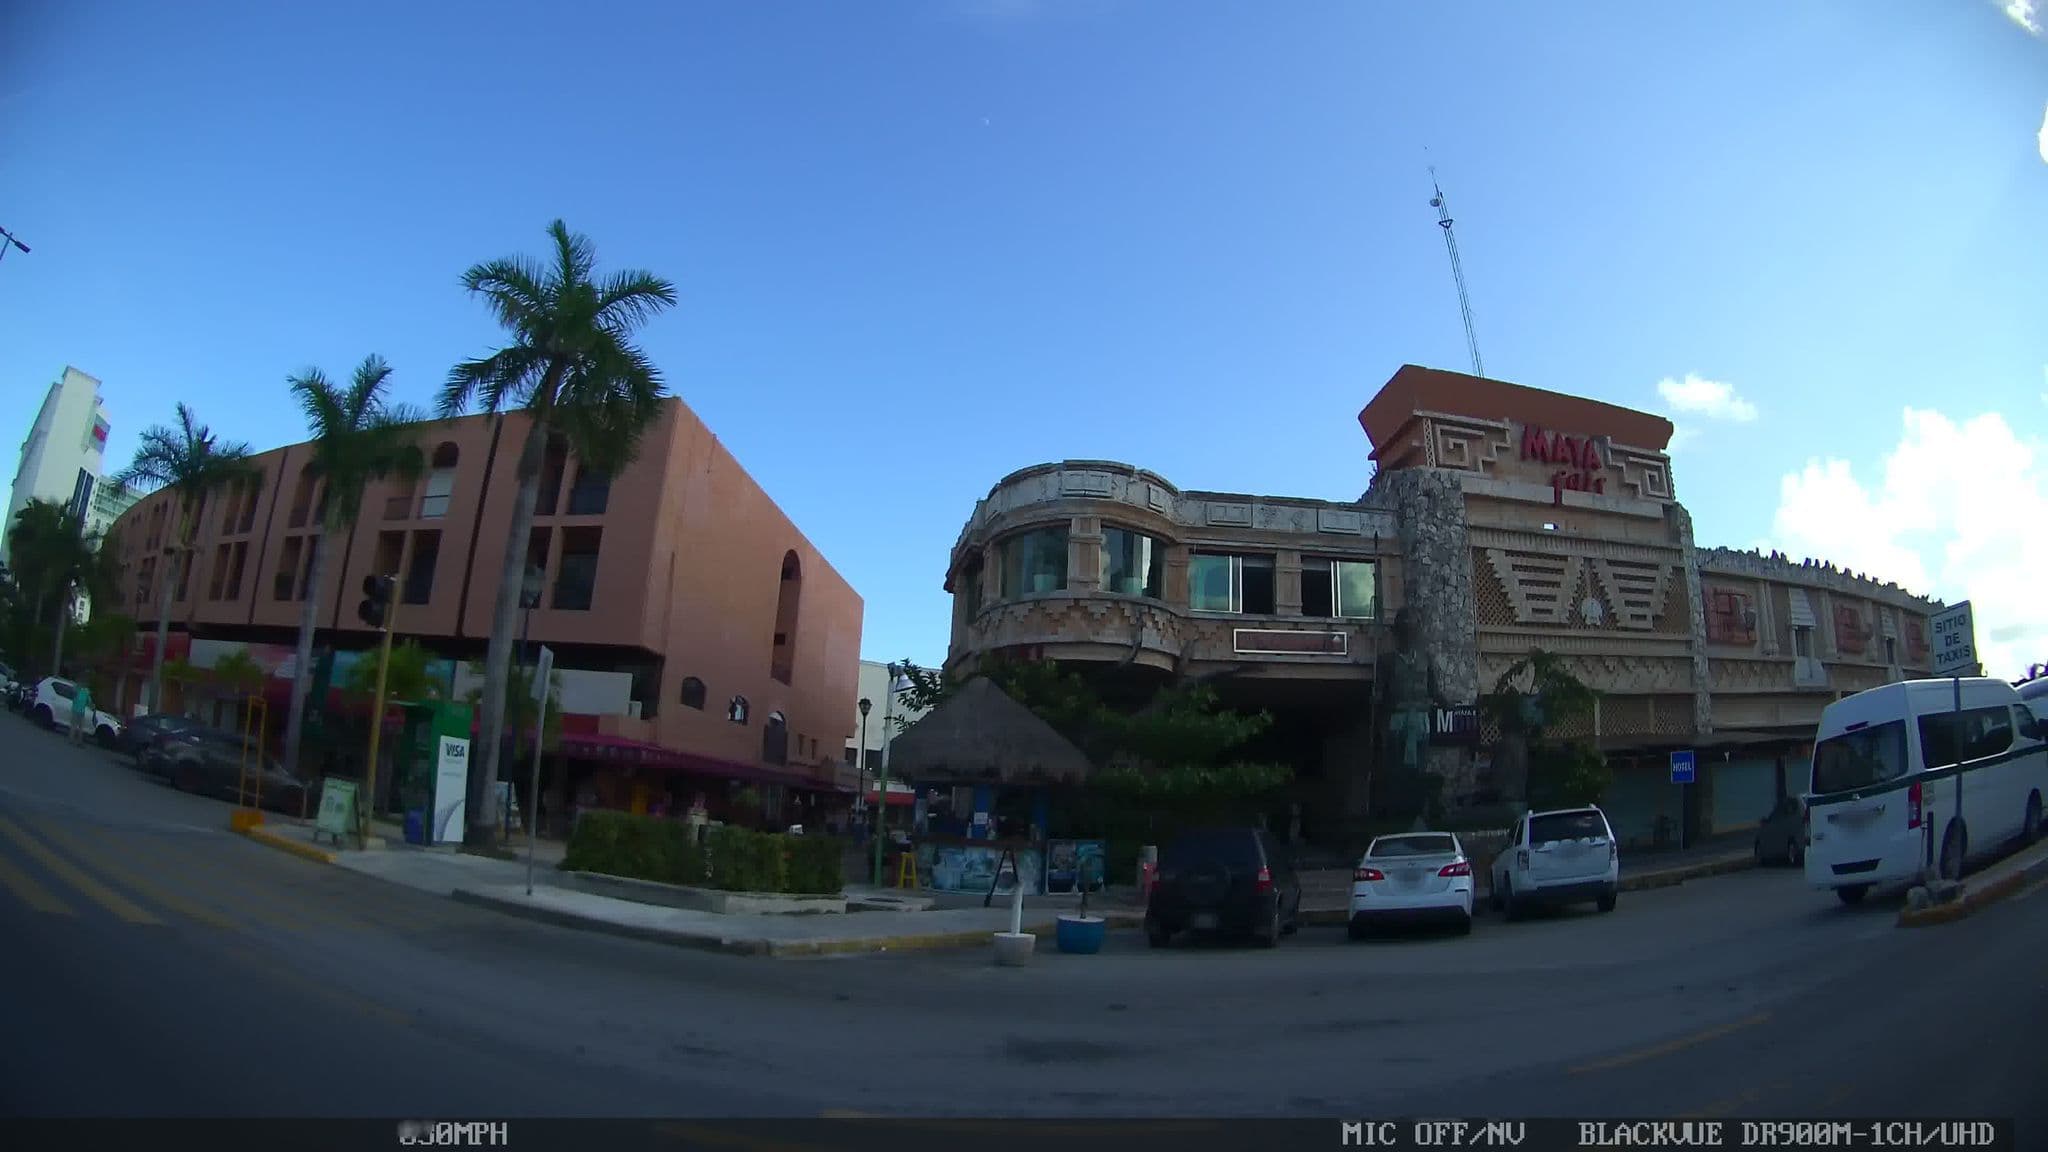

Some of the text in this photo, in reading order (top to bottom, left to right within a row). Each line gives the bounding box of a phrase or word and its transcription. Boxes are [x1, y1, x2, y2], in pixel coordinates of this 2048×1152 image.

[1935, 614, 1967, 633] SITIO
[1945, 632, 1961, 647] DE
[1936, 644, 1971, 664] TAXIS
[445, 743, 465, 758] VISA
[1672, 761, 1692, 772] HOTEL
